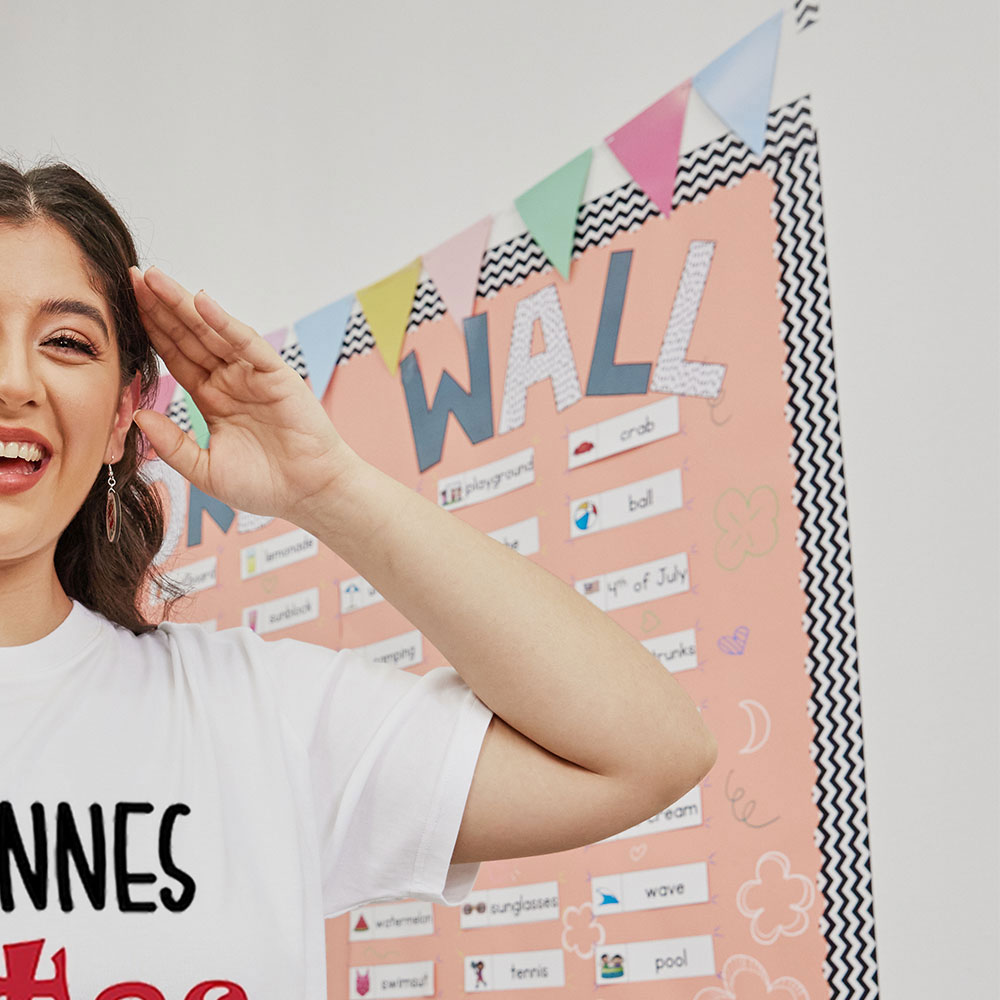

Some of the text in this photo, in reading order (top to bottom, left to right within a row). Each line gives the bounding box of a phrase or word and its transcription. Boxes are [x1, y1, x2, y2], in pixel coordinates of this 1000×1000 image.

[400, 239, 728, 474] WALL
[620, 417, 655, 441] crab
[465, 453, 535, 496] playground
[628, 489, 654, 512] ball
[266, 539, 313, 562] lemonade
[633, 571, 650, 593] of
[656, 566, 689, 588] July
[645, 882, 685, 899] wave
[490, 895, 559, 916] sunglasses
[655, 948, 688, 974] pool
[511, 966, 549, 980] tennis
